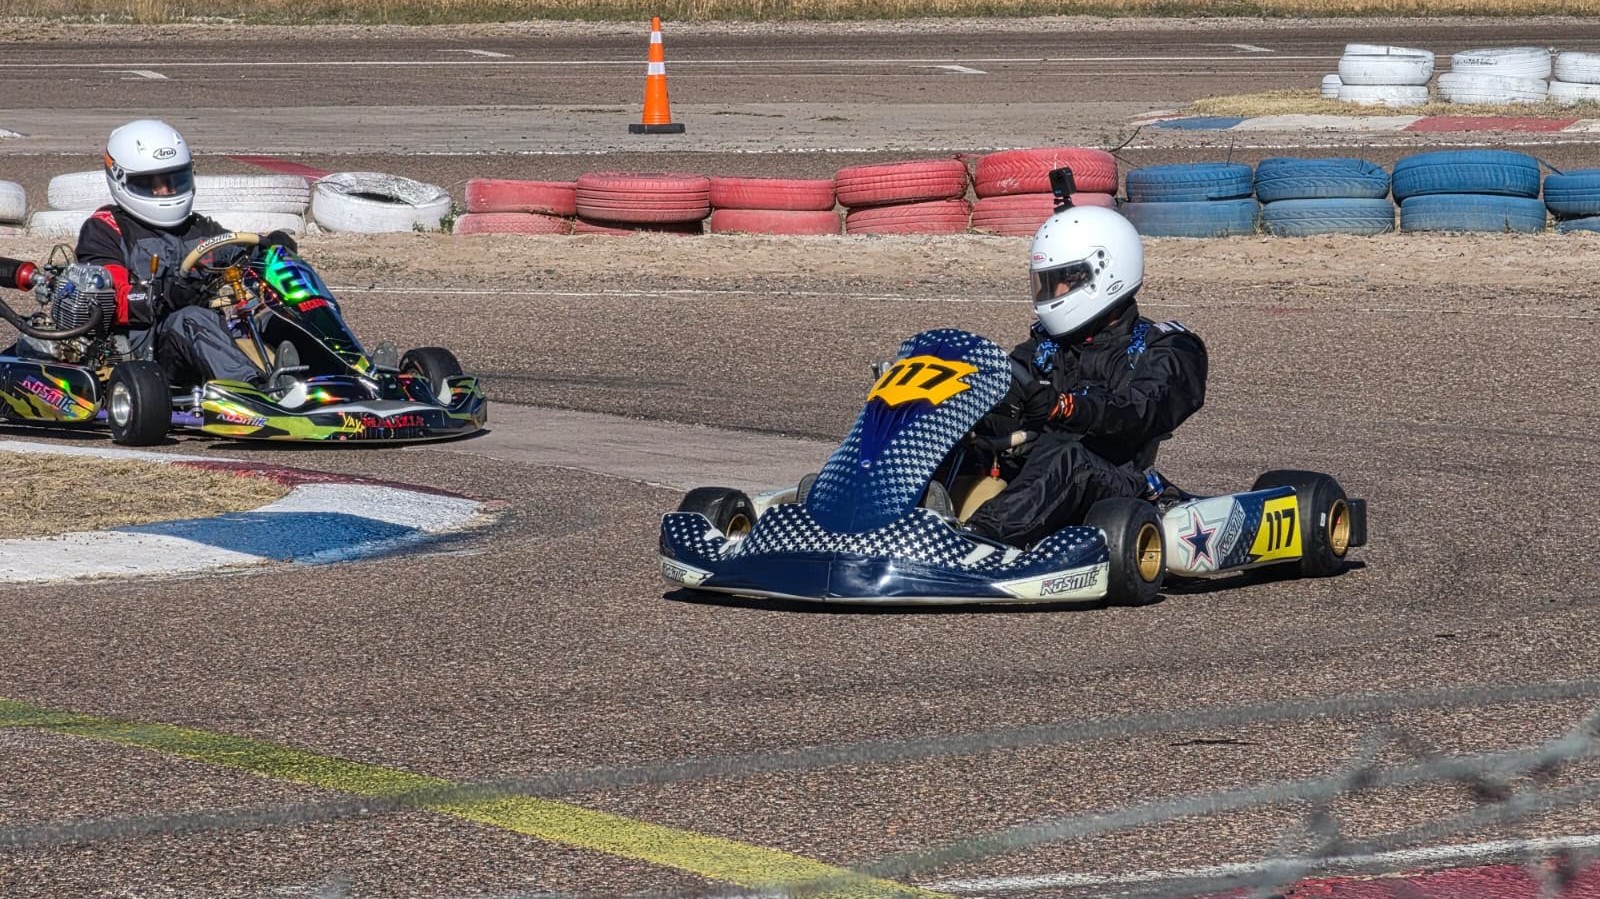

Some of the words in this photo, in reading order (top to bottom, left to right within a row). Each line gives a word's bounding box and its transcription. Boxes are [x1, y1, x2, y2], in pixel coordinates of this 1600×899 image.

[155, 148, 174, 157] Arai
[877, 362, 958, 391] 117
[21, 376, 77, 413] KOSMIC
[1265, 507, 1295, 552] 117
[1040, 569, 1100, 597] KOSMIC
